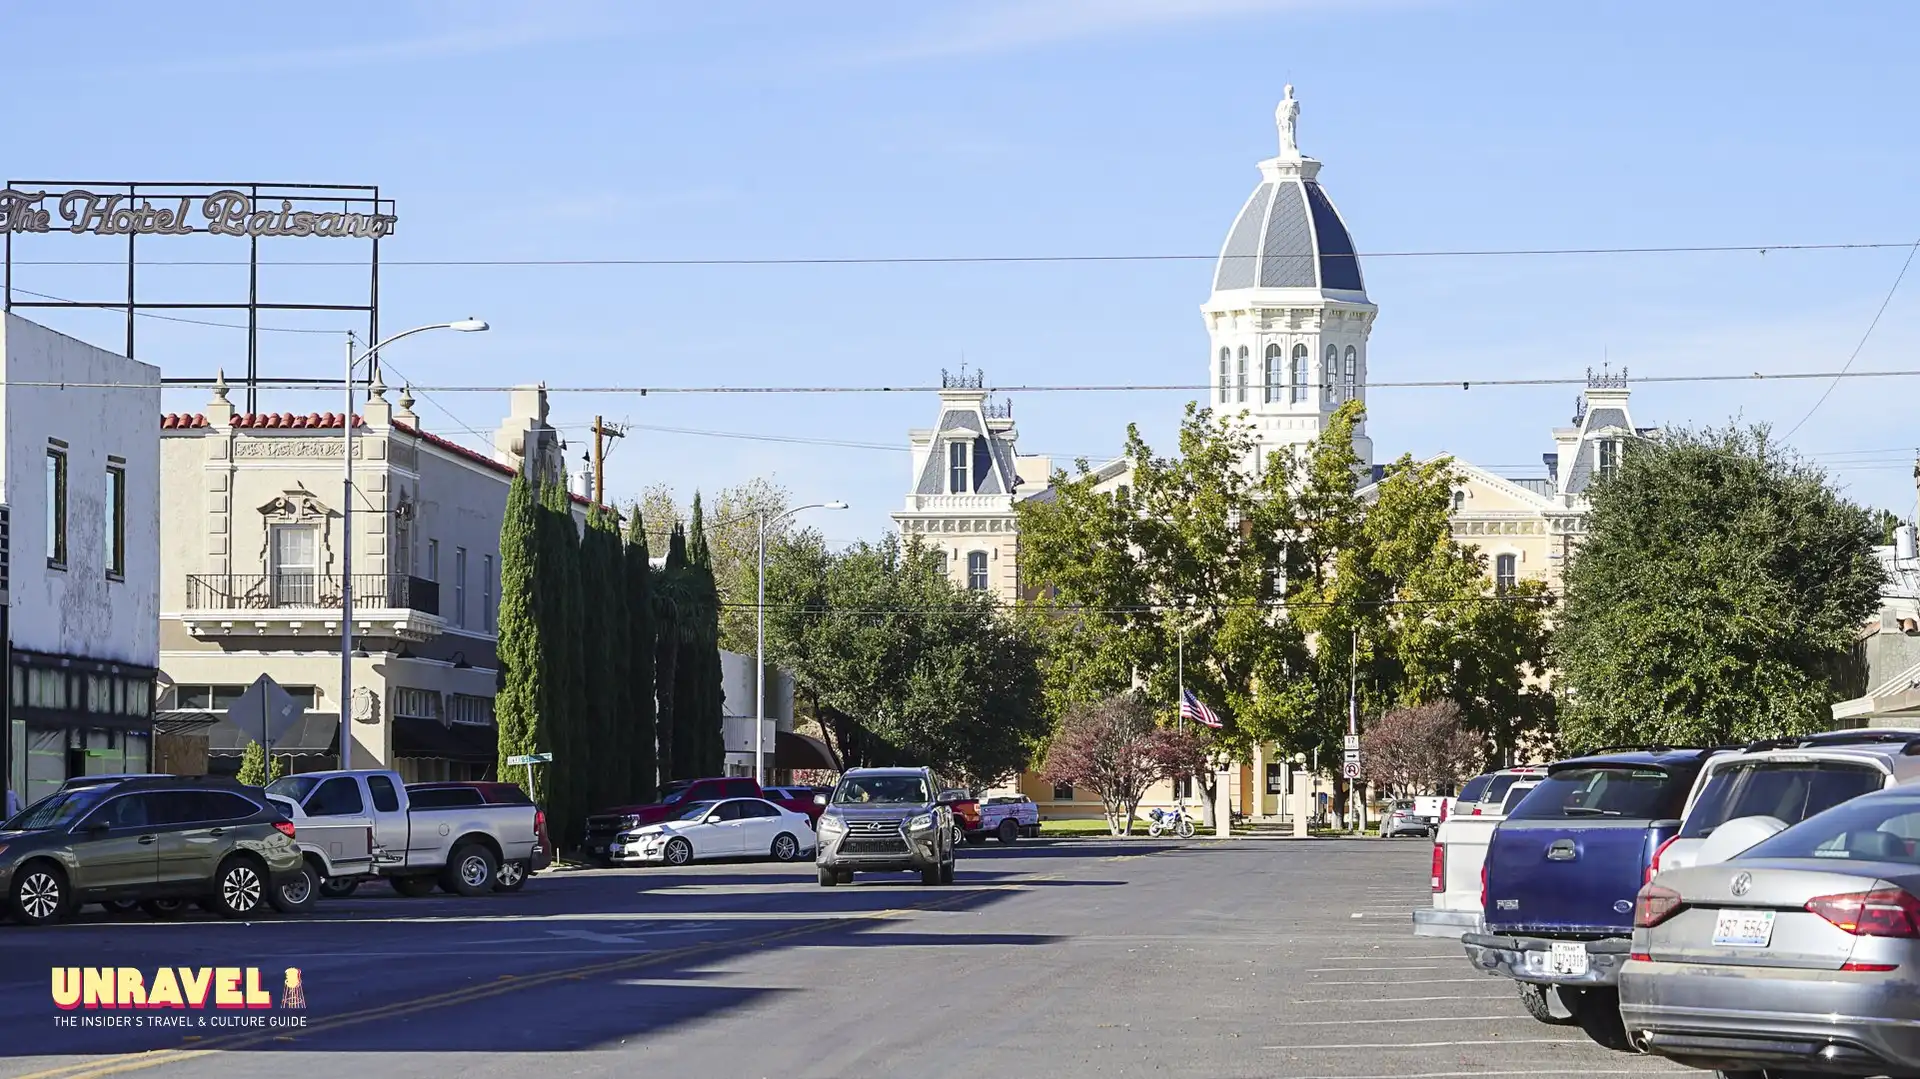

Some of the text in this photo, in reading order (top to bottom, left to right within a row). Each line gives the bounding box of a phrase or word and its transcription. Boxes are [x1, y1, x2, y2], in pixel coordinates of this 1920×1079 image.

[0, 189, 398, 238] The Hotel Paisano
